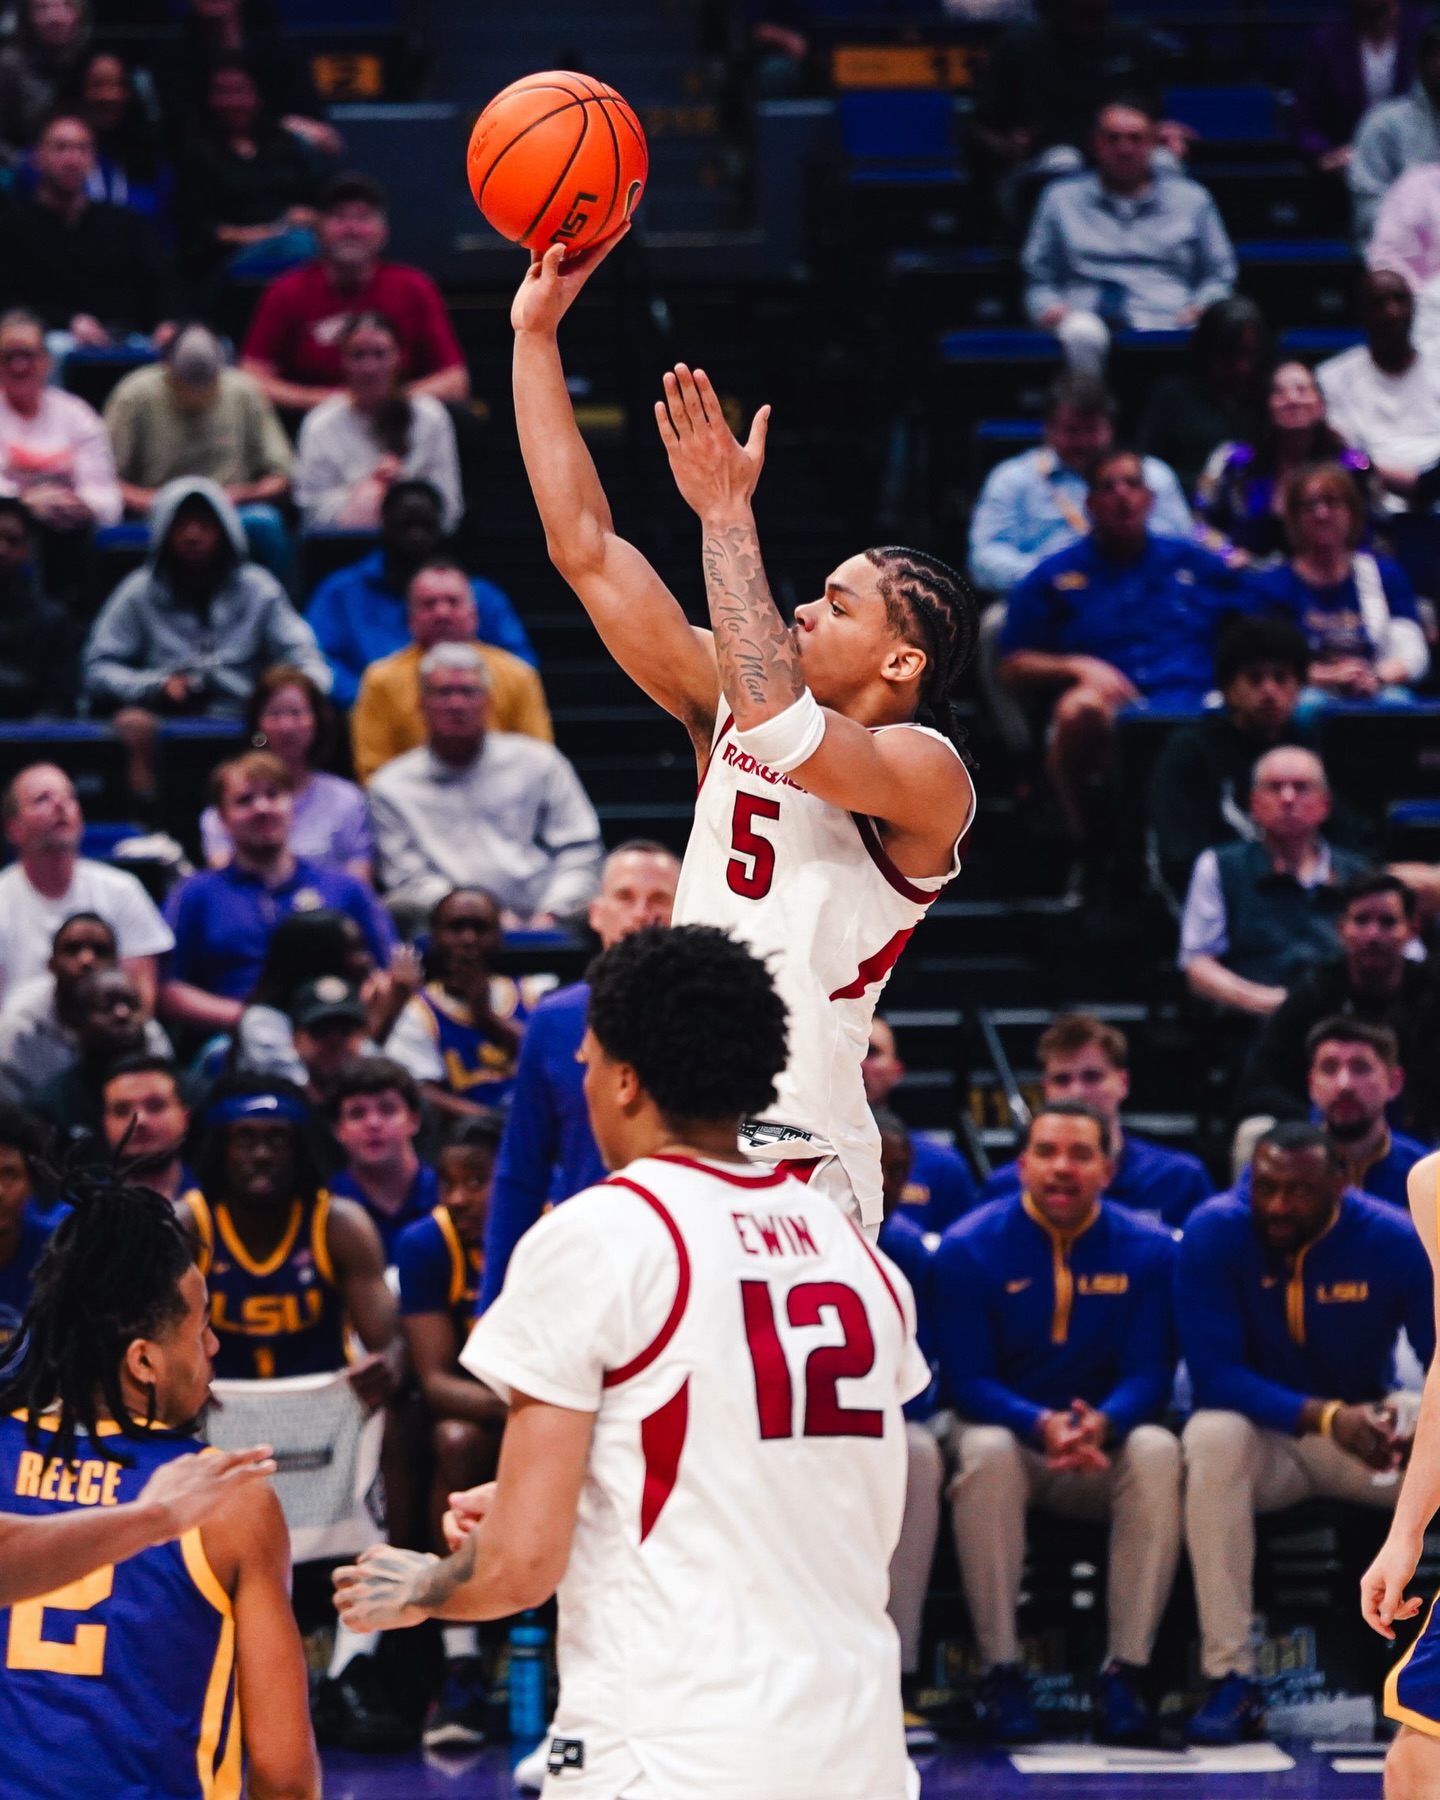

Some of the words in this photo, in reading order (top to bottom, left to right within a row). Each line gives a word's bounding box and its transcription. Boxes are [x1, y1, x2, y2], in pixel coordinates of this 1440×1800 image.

[549, 191, 599, 246] LSU
[719, 591, 749, 635] No
[734, 638, 769, 704] Man
[726, 789, 781, 901] 5
[731, 1212, 820, 1256] EWIN
[1077, 1272, 1130, 1295] LSU
[210, 1288, 322, 1336] LSU
[740, 1279, 884, 1440] 12
[15, 1450, 123, 1506] REECE
